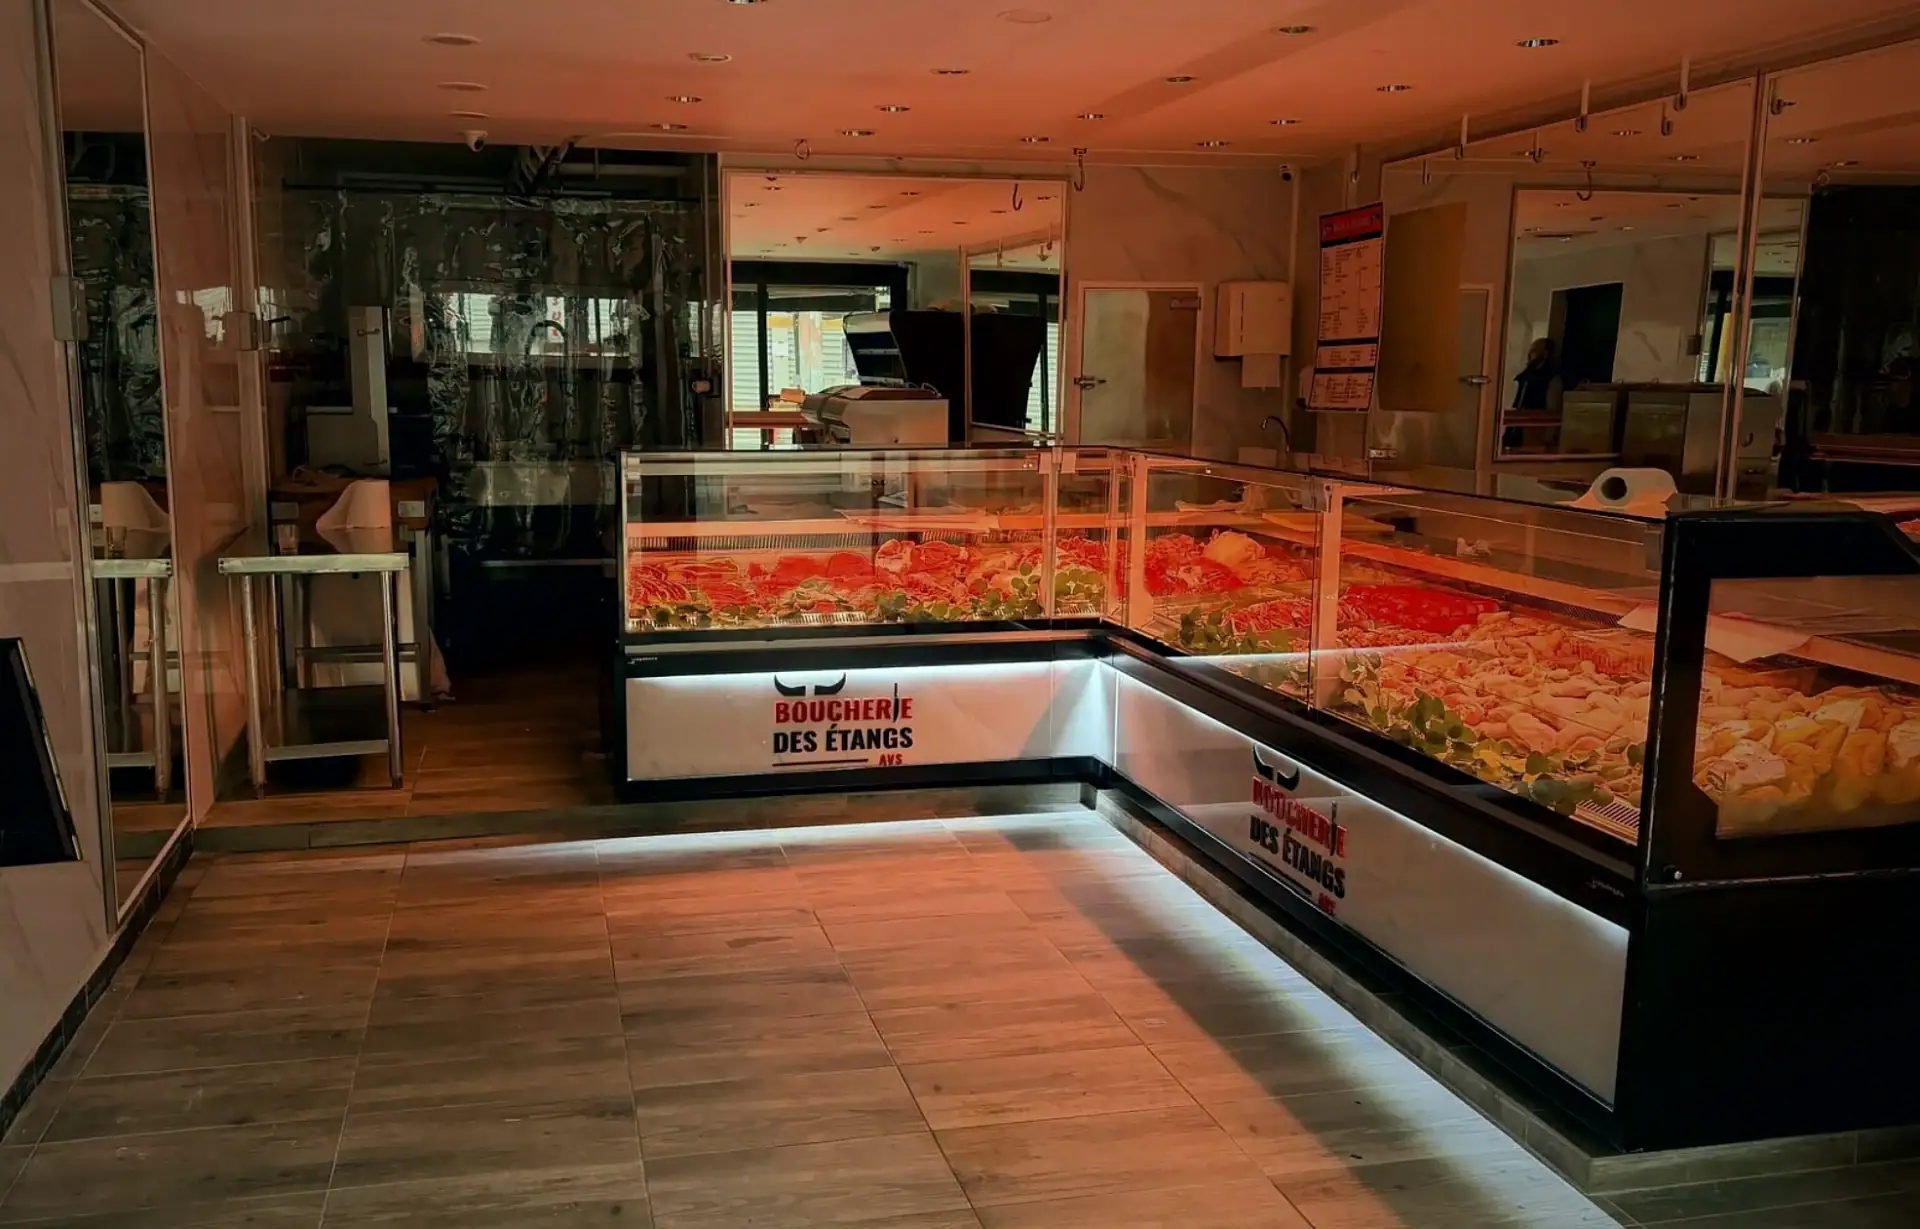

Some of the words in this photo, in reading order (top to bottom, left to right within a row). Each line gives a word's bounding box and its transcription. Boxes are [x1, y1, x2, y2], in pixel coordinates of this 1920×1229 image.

[775, 697, 913, 724] BOUCHERIE
[773, 730, 818, 754] DES
[825, 723, 914, 752] ÉTANGS
[878, 753, 904, 766] AVS
[1249, 814, 1279, 855] DES
[1282, 827, 1346, 899] ÉTANGS
